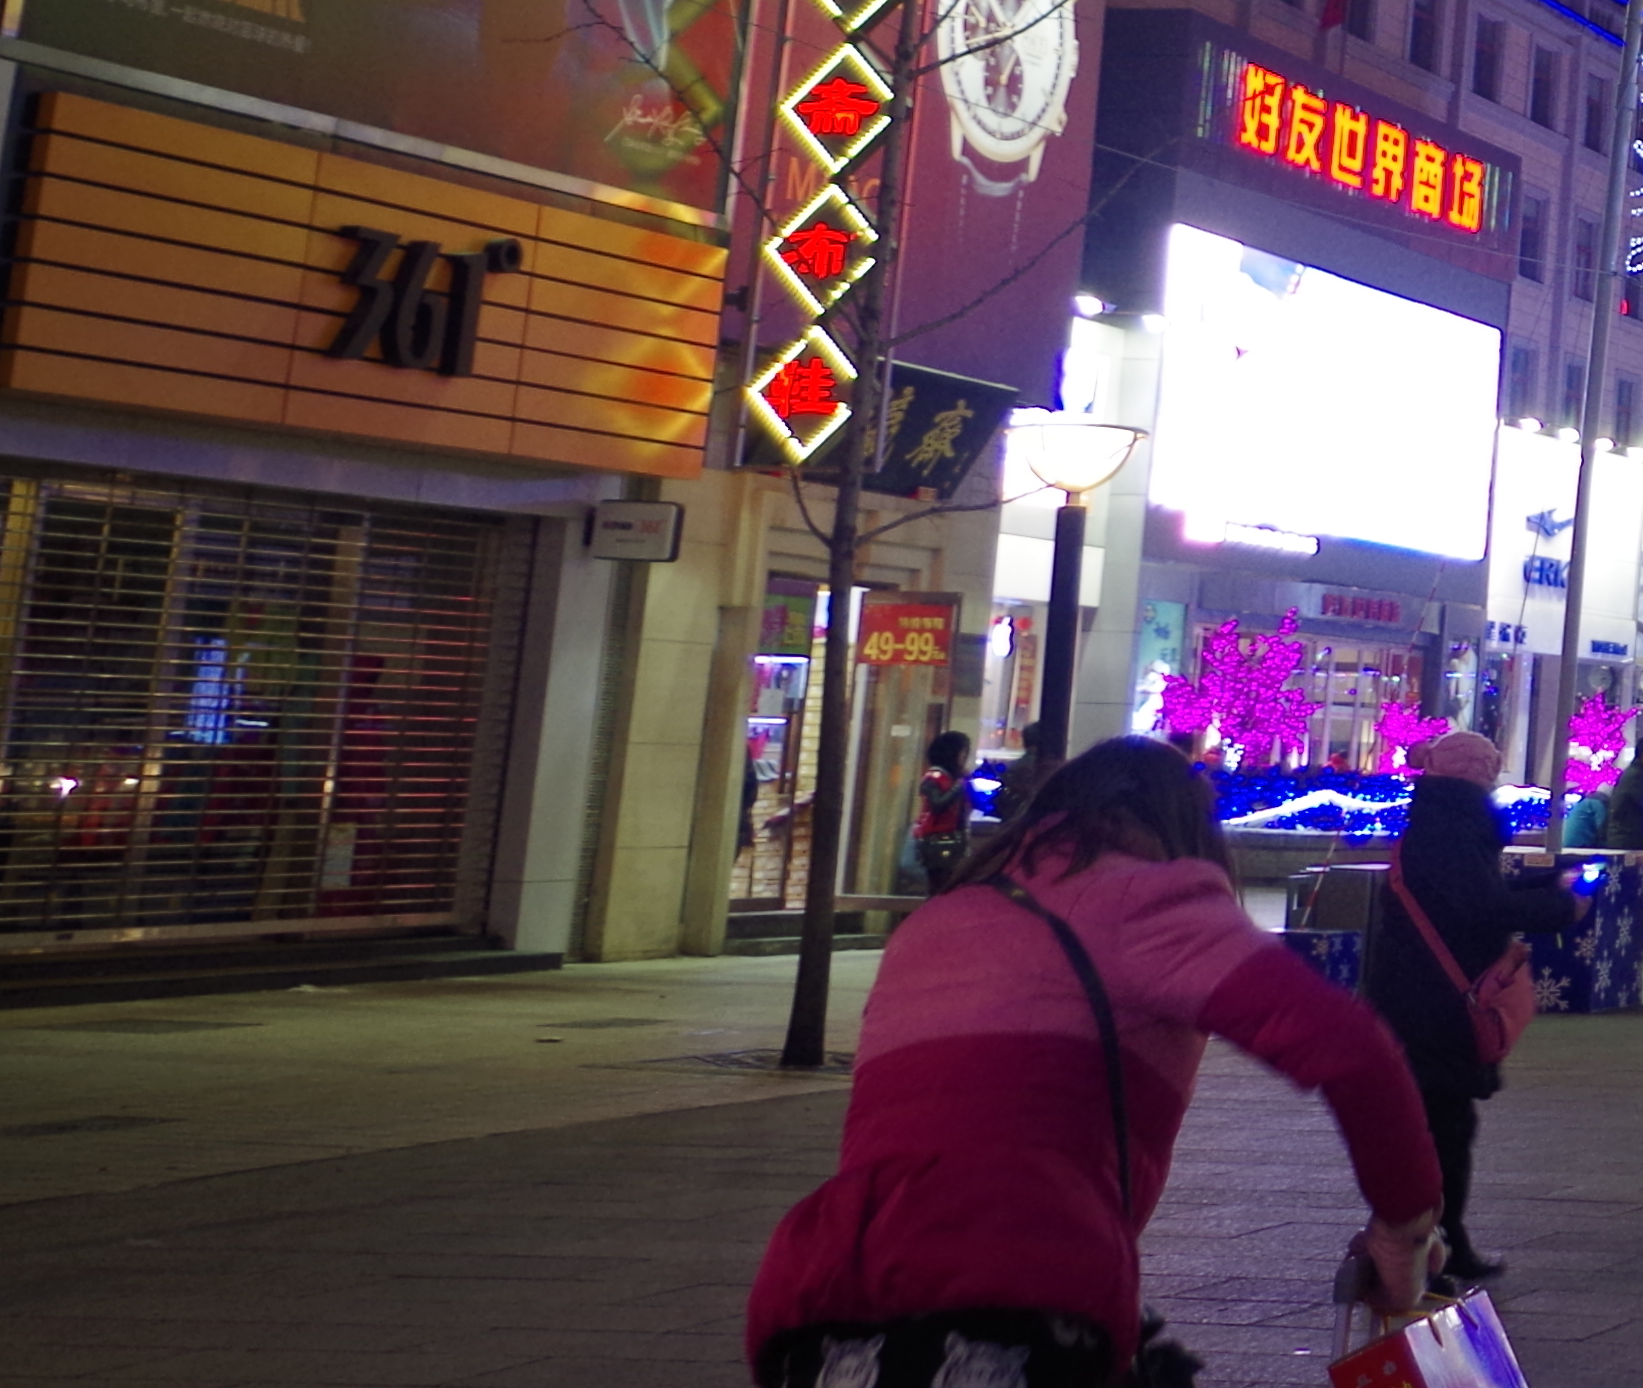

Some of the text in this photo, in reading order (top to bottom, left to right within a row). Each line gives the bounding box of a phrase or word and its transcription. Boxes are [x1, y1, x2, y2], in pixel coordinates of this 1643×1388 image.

[1239, 62, 1486, 234] 好友世界商场
[323, 223, 524, 379] 361°
